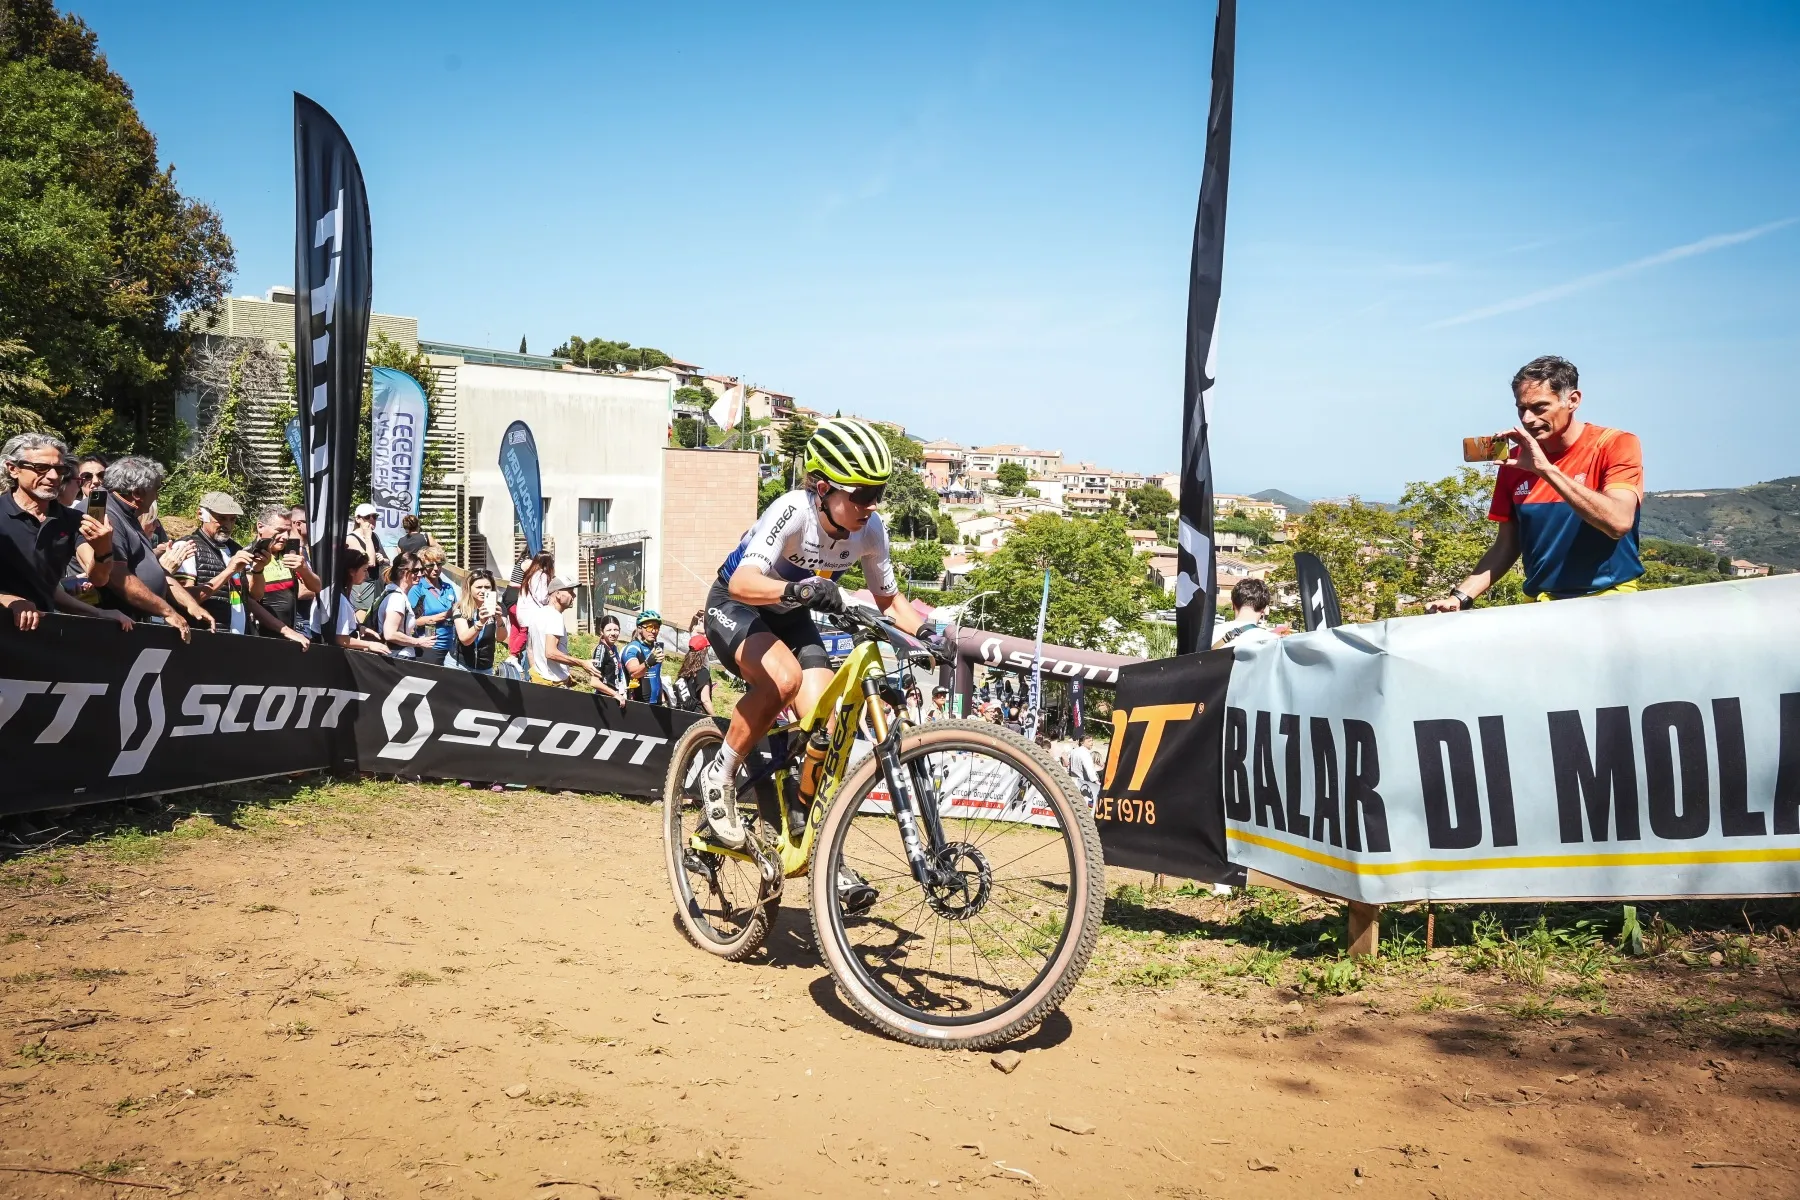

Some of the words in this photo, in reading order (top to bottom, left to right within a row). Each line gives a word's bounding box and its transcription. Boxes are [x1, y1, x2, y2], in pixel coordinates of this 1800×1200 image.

[766, 504, 797, 547] ORBEA
[708, 607, 737, 631] ORBEA
[1005, 651, 1119, 683] SCOTT
[170, 684, 371, 737] SCOTT
[439, 708, 668, 764] SCOTT
[811, 704, 855, 829] ORBEA
[1226, 706, 1391, 853] BAZAR
[1413, 715, 1518, 849] DI
[1117, 799, 1156, 824] 1978
[897, 811, 926, 862] FOX
[887, 1014, 910, 1028] RACE
